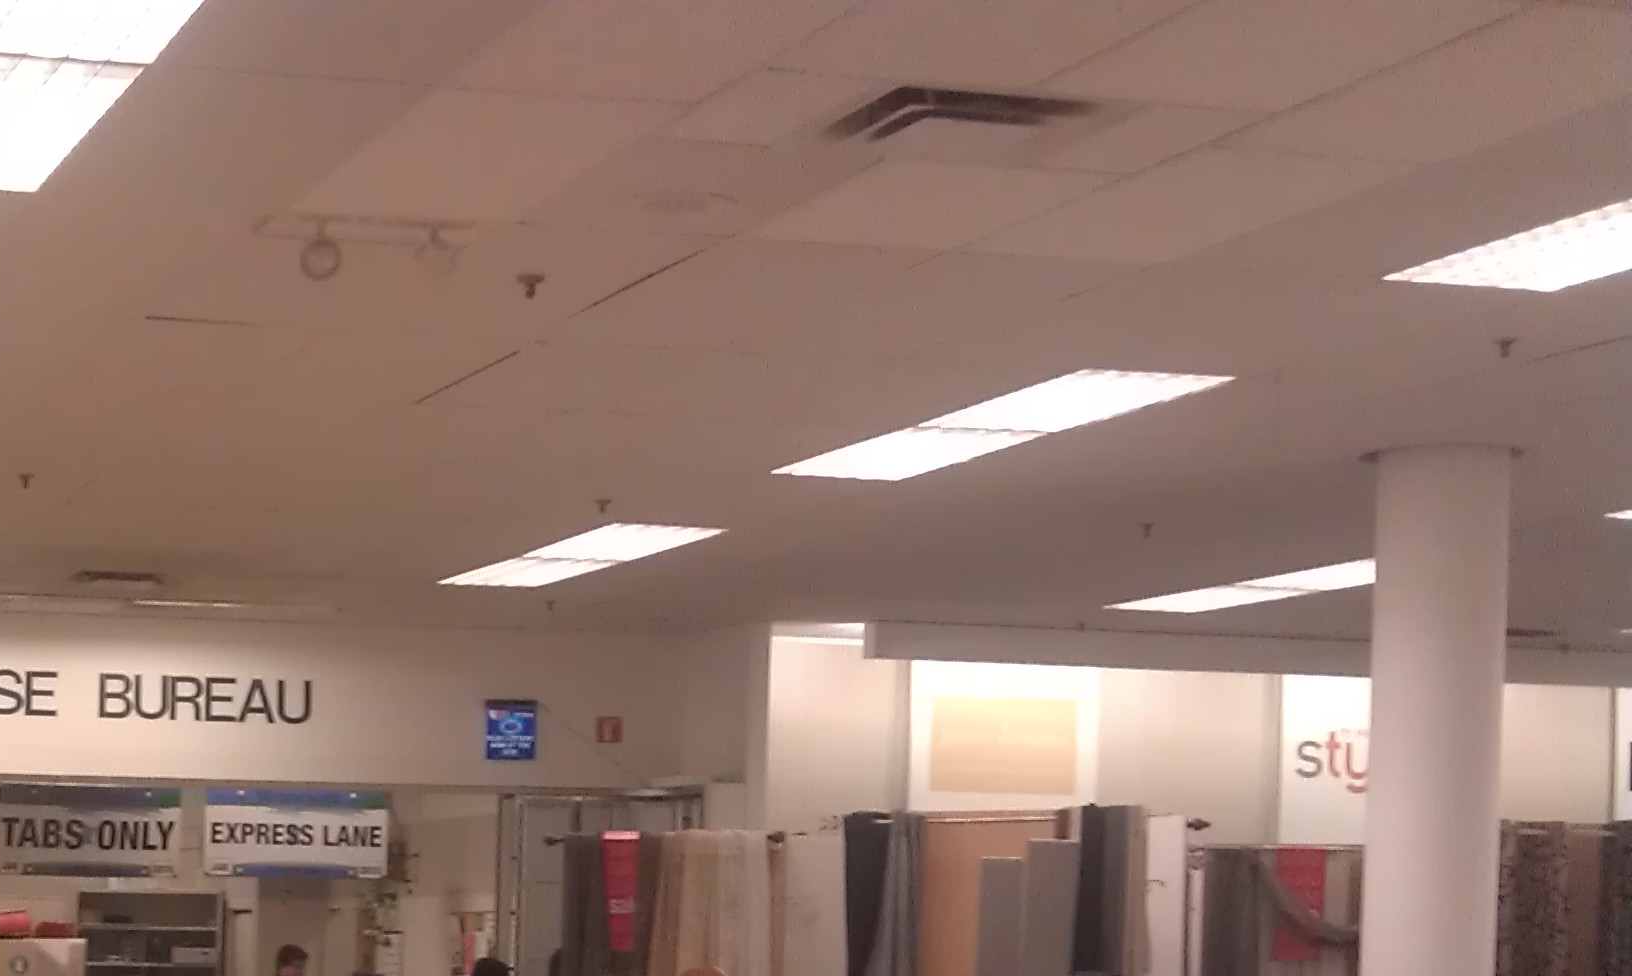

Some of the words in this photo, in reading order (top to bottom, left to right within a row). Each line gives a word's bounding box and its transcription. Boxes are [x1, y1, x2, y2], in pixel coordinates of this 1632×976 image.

[97, 672, 314, 725] BUREAU
[2, 817, 84, 850] TABS
[98, 820, 177, 852] ONLY
[211, 822, 314, 847] EXPRESS
[323, 825, 382, 849] LANE
